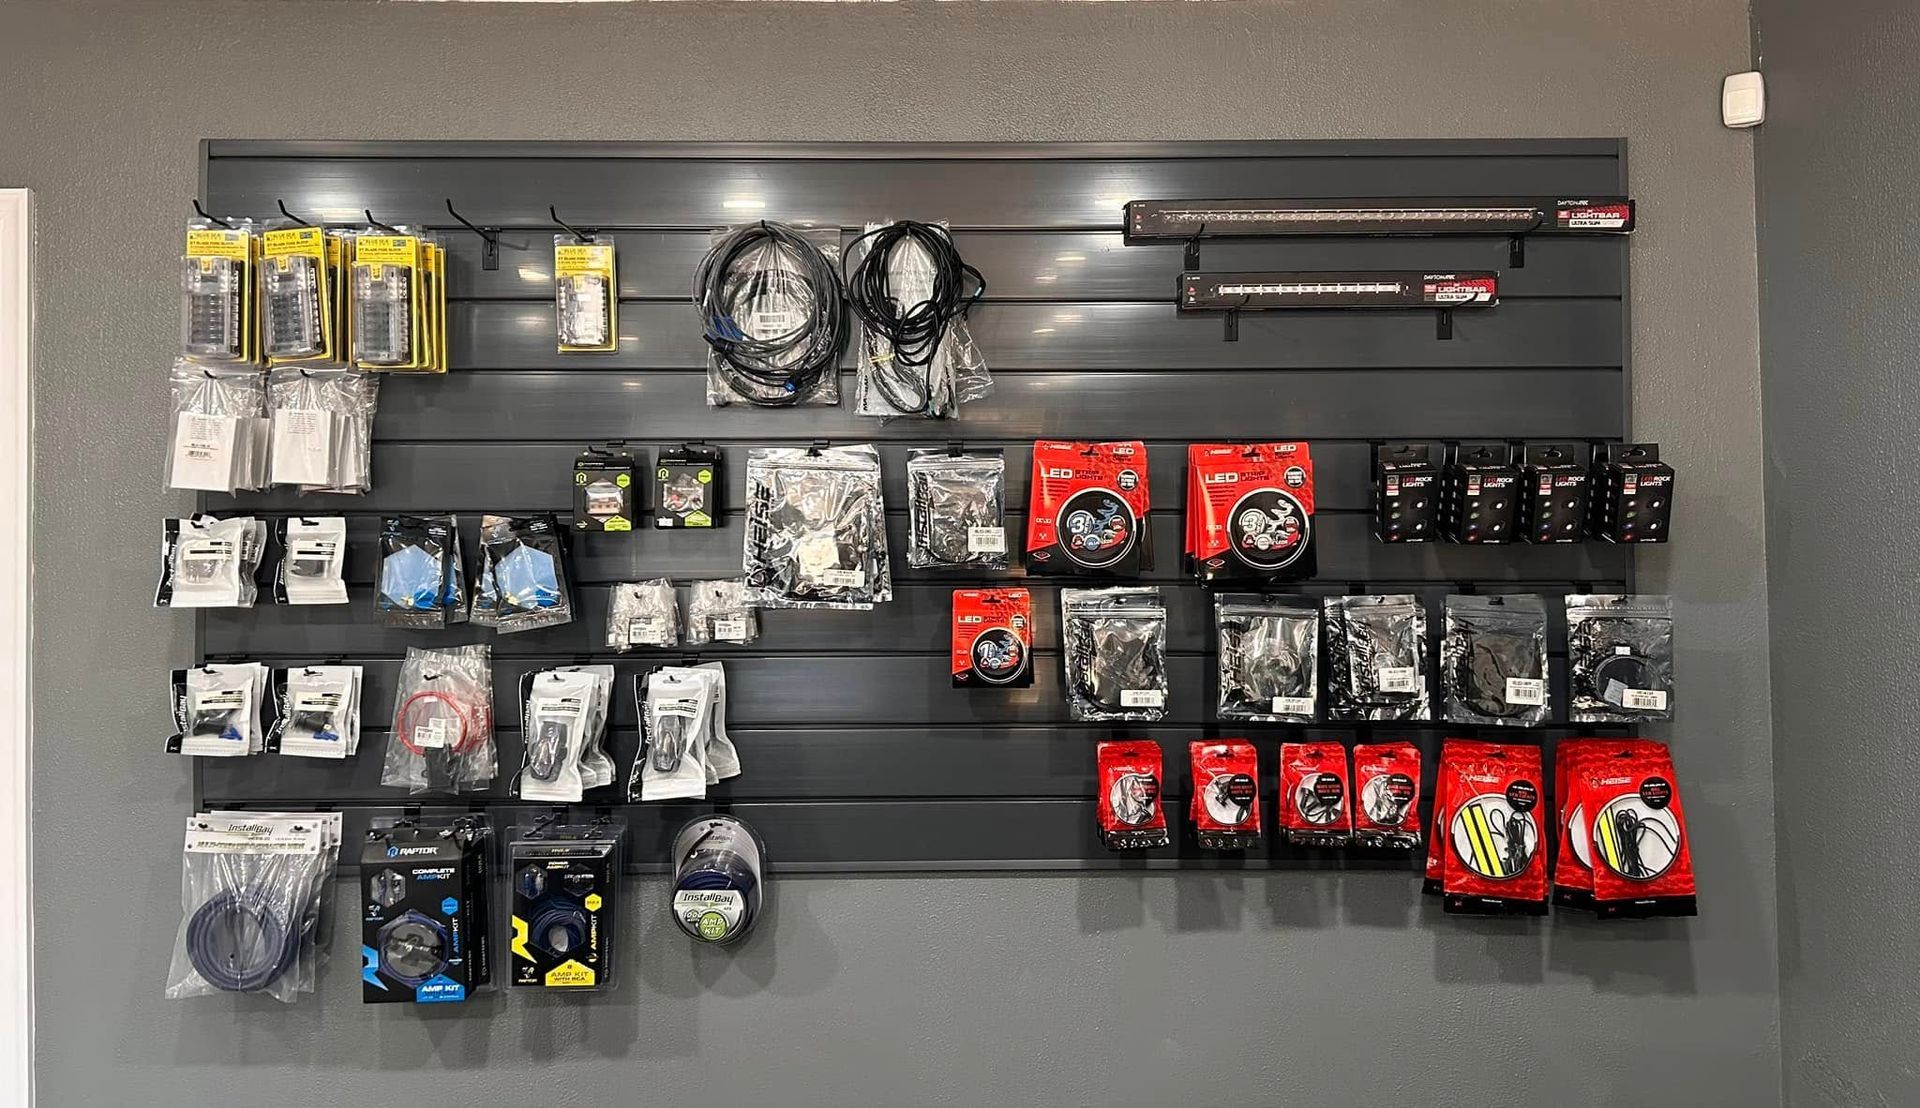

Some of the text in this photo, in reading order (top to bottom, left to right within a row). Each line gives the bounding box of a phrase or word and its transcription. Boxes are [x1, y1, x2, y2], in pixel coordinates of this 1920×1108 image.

[1112, 447, 1135, 456] LED
[1274, 444, 1296, 452] LED
[1040, 468, 1073, 479] LED
[1205, 472, 1238, 484] LED
[753, 481, 771, 565] HEISE
[1070, 516, 1084, 534] 3
[1242, 517, 1257, 534] 3
[958, 615, 982, 623] LED
[176, 694, 188, 732] stallBay
[228, 824, 274, 836] InstallBay
[400, 847, 438, 856] RAPTOR
[684, 893, 734, 906] InstallBay
